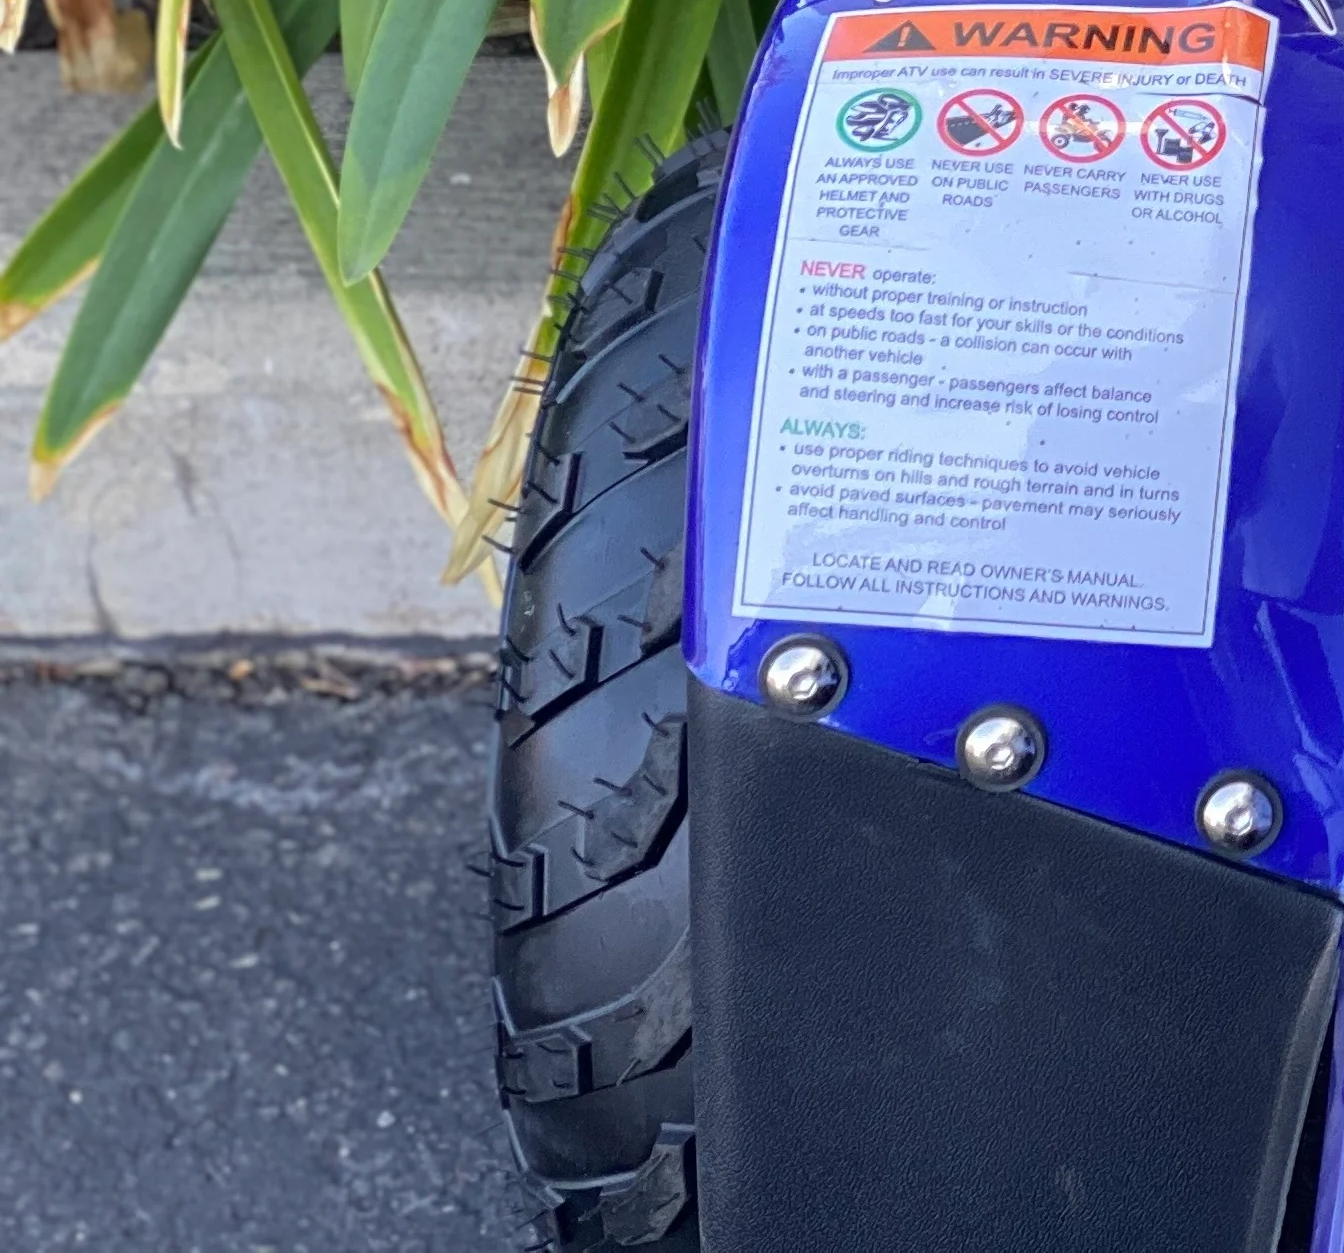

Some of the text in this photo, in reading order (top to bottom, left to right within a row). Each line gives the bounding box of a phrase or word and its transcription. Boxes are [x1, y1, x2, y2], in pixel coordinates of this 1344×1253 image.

[954, 21, 1215, 54] WARNING
[832, 66, 1246, 87] Improper ATV use can result in SEVERE INJURY or DEATH
[824, 157, 915, 169] ALWAYS USE
[931, 159, 1013, 175] NEVER USE
[815, 173, 918, 186] AN APPROVED
[1023, 164, 1126, 182] NEVER CARRY
[1140, 173, 1222, 188] NEVER USE
[931, 176, 1008, 191] ON PUBLIC
[1024, 182, 1120, 199] PASSENGERS
[819, 189, 910, 205] HELMET AND
[942, 193, 993, 207] ROADS
[1134, 190, 1224, 206] WITH DRUGS
[816, 207, 908, 221] PROTECTIVE
[1131, 206, 1221, 224] OR ALCOHOL
[838, 224, 880, 237] GEAR
[800, 260, 865, 279] NEVER
[812, 283, 868, 299] without
[871, 289, 923, 304] proper
[1008, 297, 1088, 316] instruction
[829, 306, 1184, 344] speeds fast for your skills conditions
[830, 326, 1132, 360] public roads collision occur with
[804, 345, 923, 365] another vehicle
[802, 364, 1152, 403] with passenger passengers affect balance
[833, 388, 1159, 423] steering increase risk losing control
[793, 443, 1160, 480] use proper riding techniques avoid vehicle
[791, 464, 1179, 501] overturns hills rough terrain turns
[789, 484, 1181, 524] avoid paved surfaces pavement may seriously
[787, 502, 1006, 530] affect handling control
[812, 552, 881, 571] LOCATE
[884, 558, 922, 575] AND
[927, 560, 976, 577] READ
[980, 564, 1063, 583] OWNER'S
[781, 571, 1168, 611] FOLLOW ALL INSTRUCTIONS AND WARNINGS.
